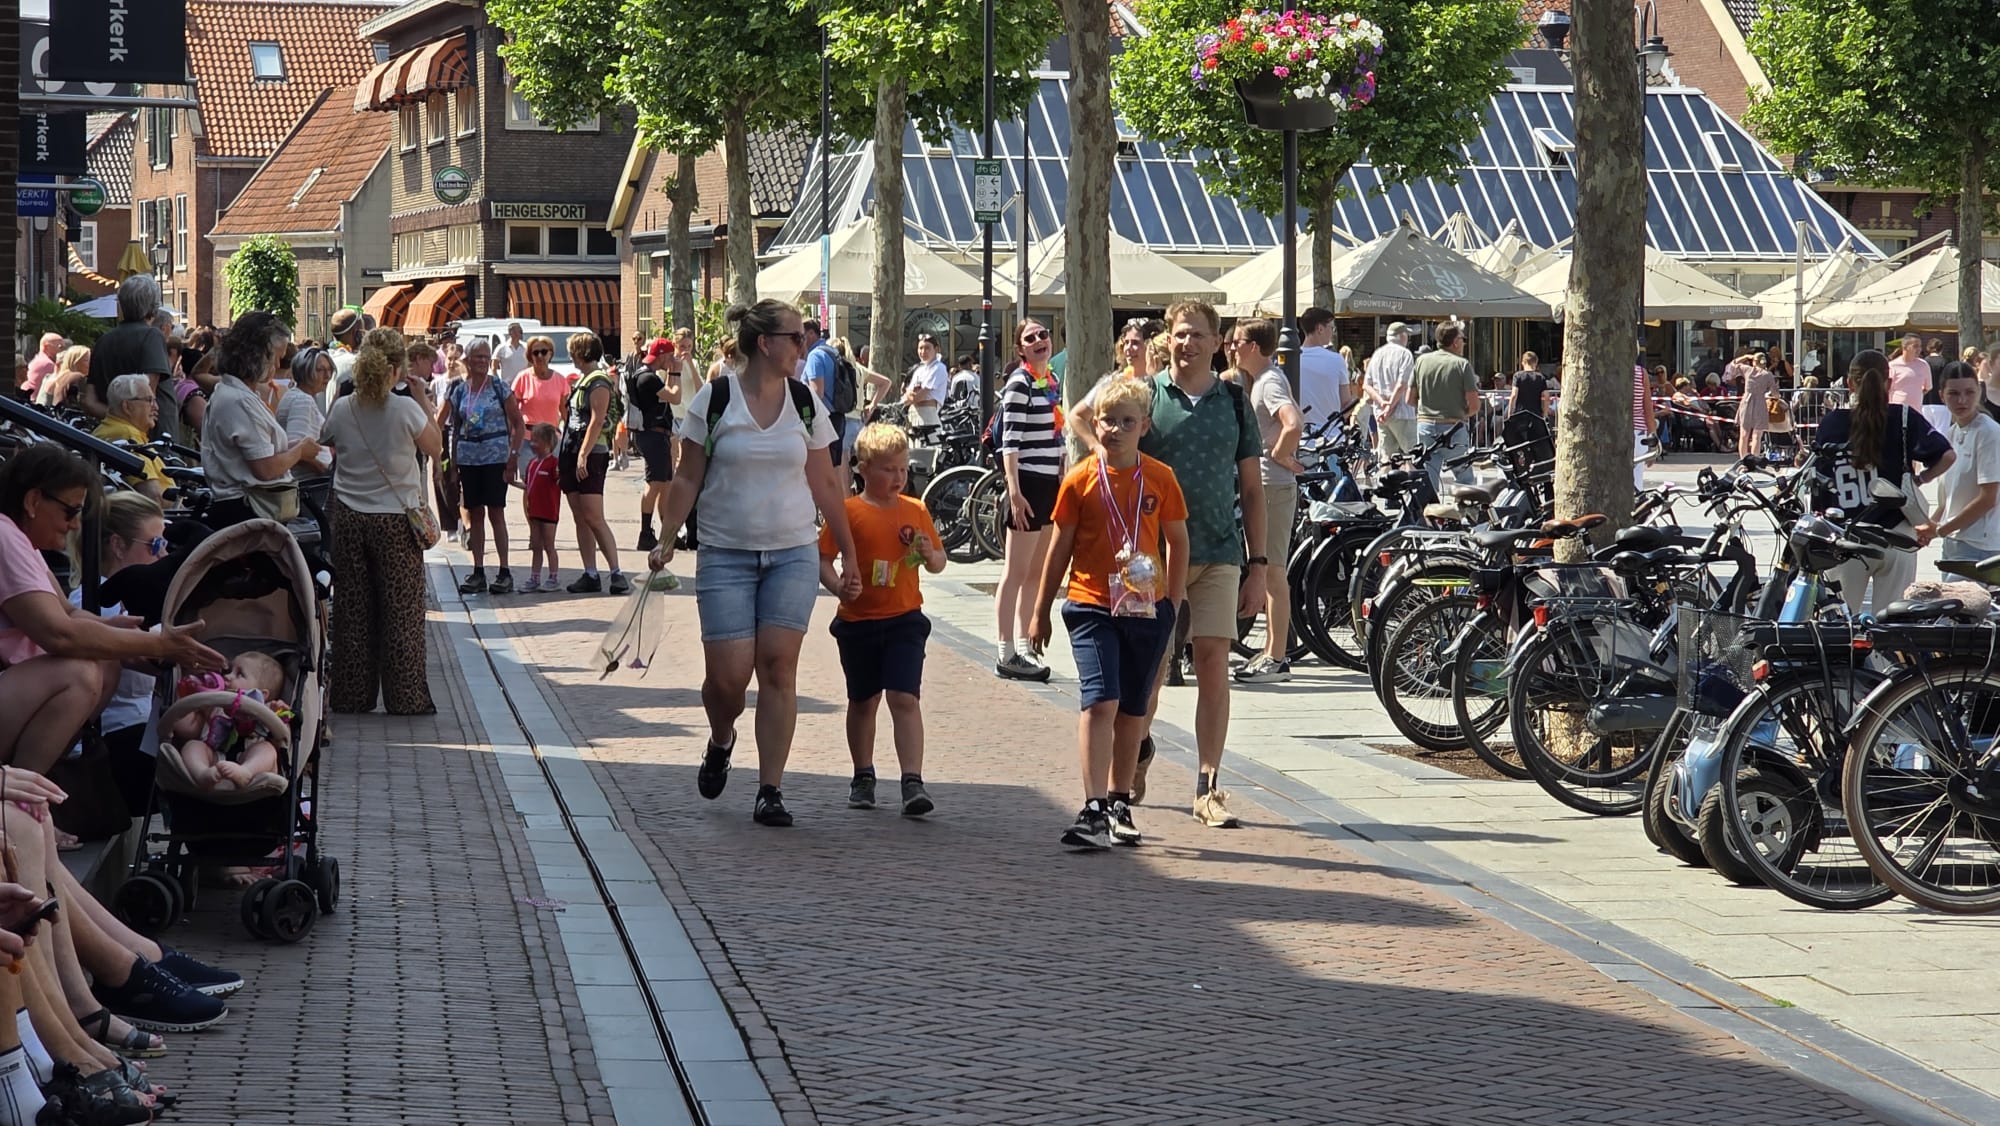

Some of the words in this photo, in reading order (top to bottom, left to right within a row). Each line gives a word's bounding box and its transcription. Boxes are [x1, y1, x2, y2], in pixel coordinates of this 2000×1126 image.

[109, 0, 129, 62] rkerk
[494, 204, 585, 218] HENGELSPORT
[1835, 464, 1879, 508] 60
